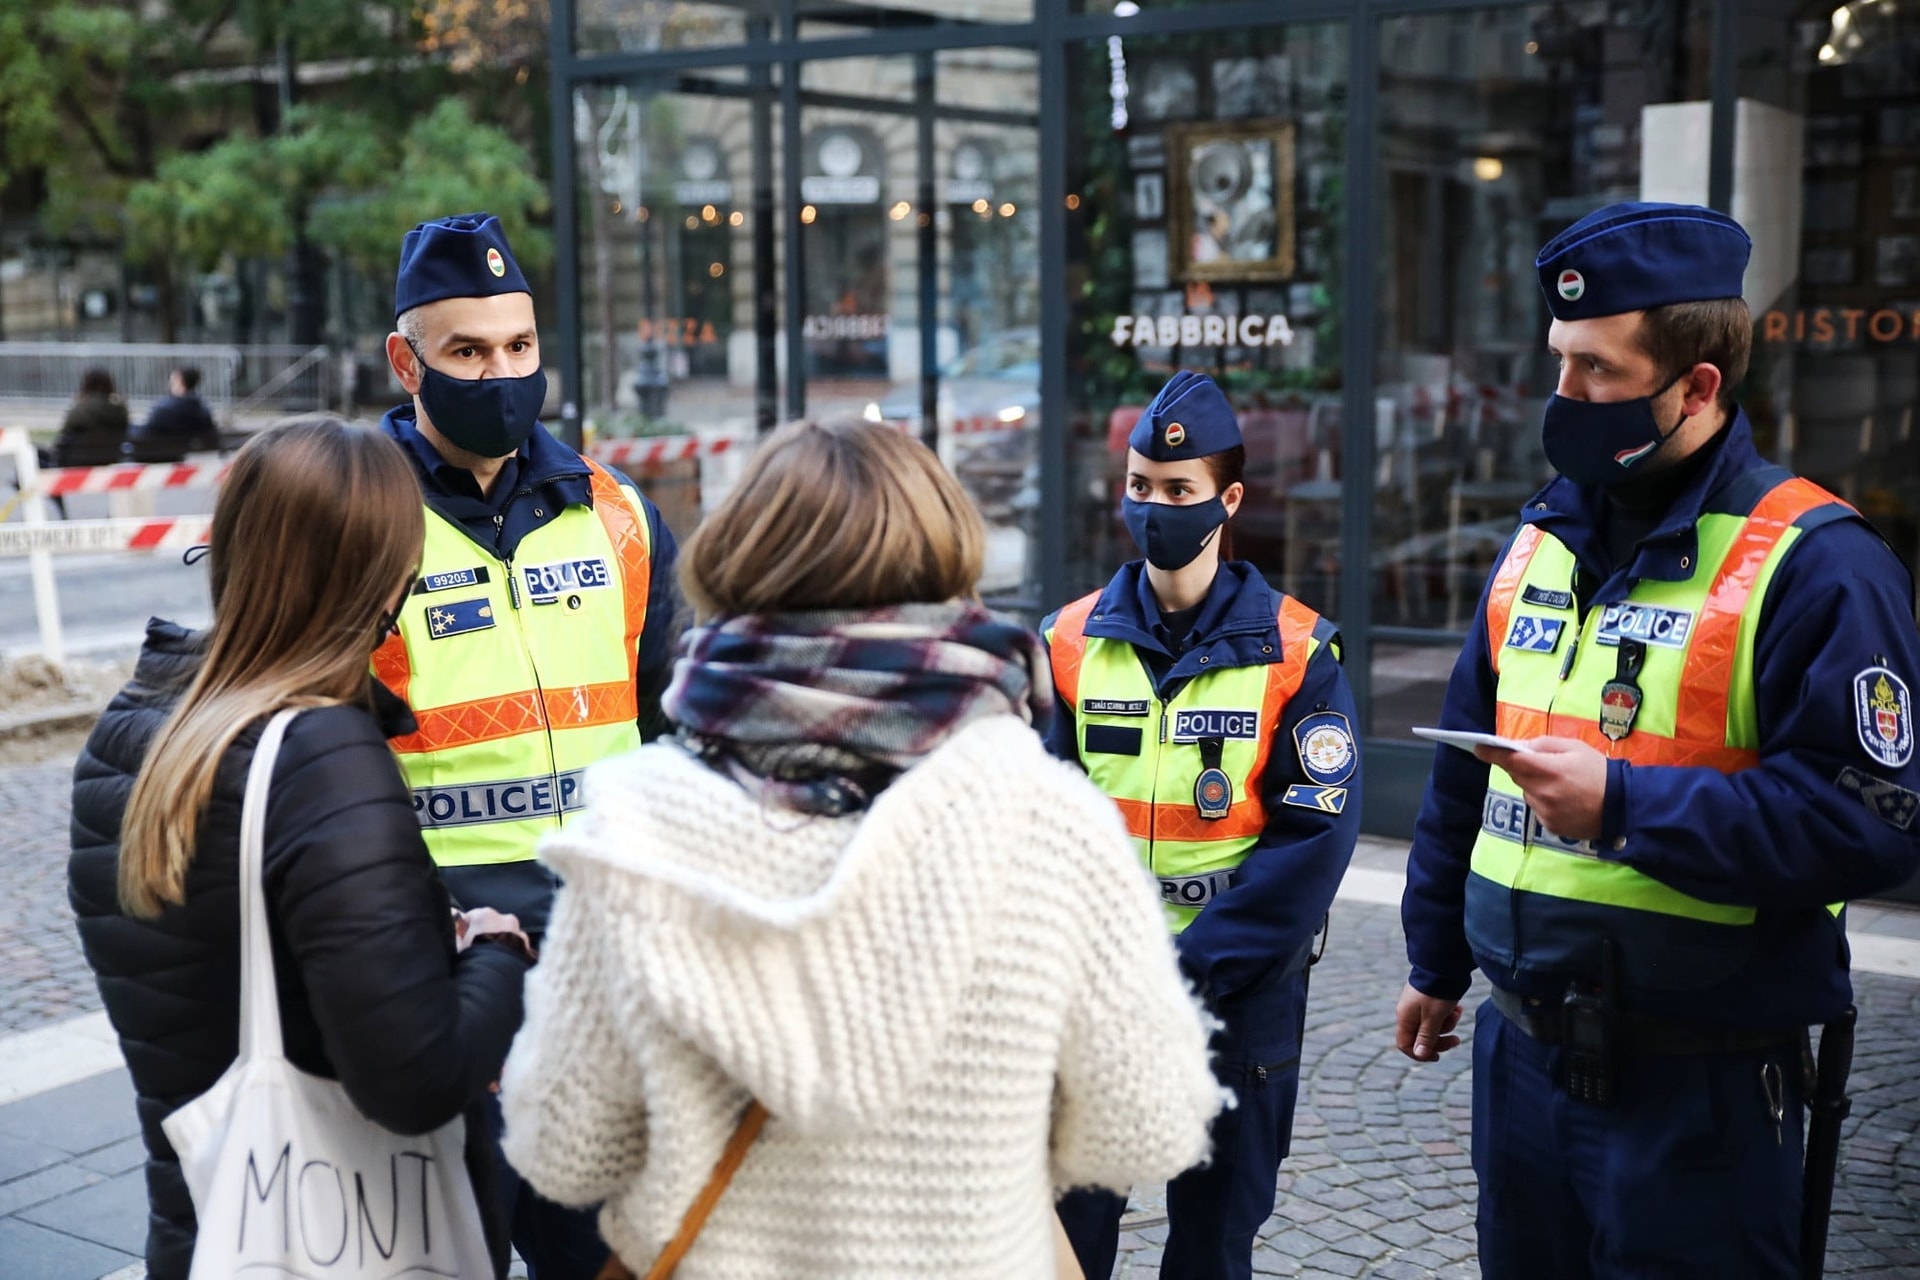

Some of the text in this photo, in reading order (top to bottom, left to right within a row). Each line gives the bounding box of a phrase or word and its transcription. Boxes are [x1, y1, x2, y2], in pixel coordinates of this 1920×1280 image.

[1111, 315, 1294, 347] FABBRICA
[433, 572, 468, 587] 99205
[527, 563, 610, 592] POLICE
[1603, 608, 1689, 641] POLICE
[1177, 714, 1256, 735] POLICE
[238, 1140, 435, 1269] MONT
